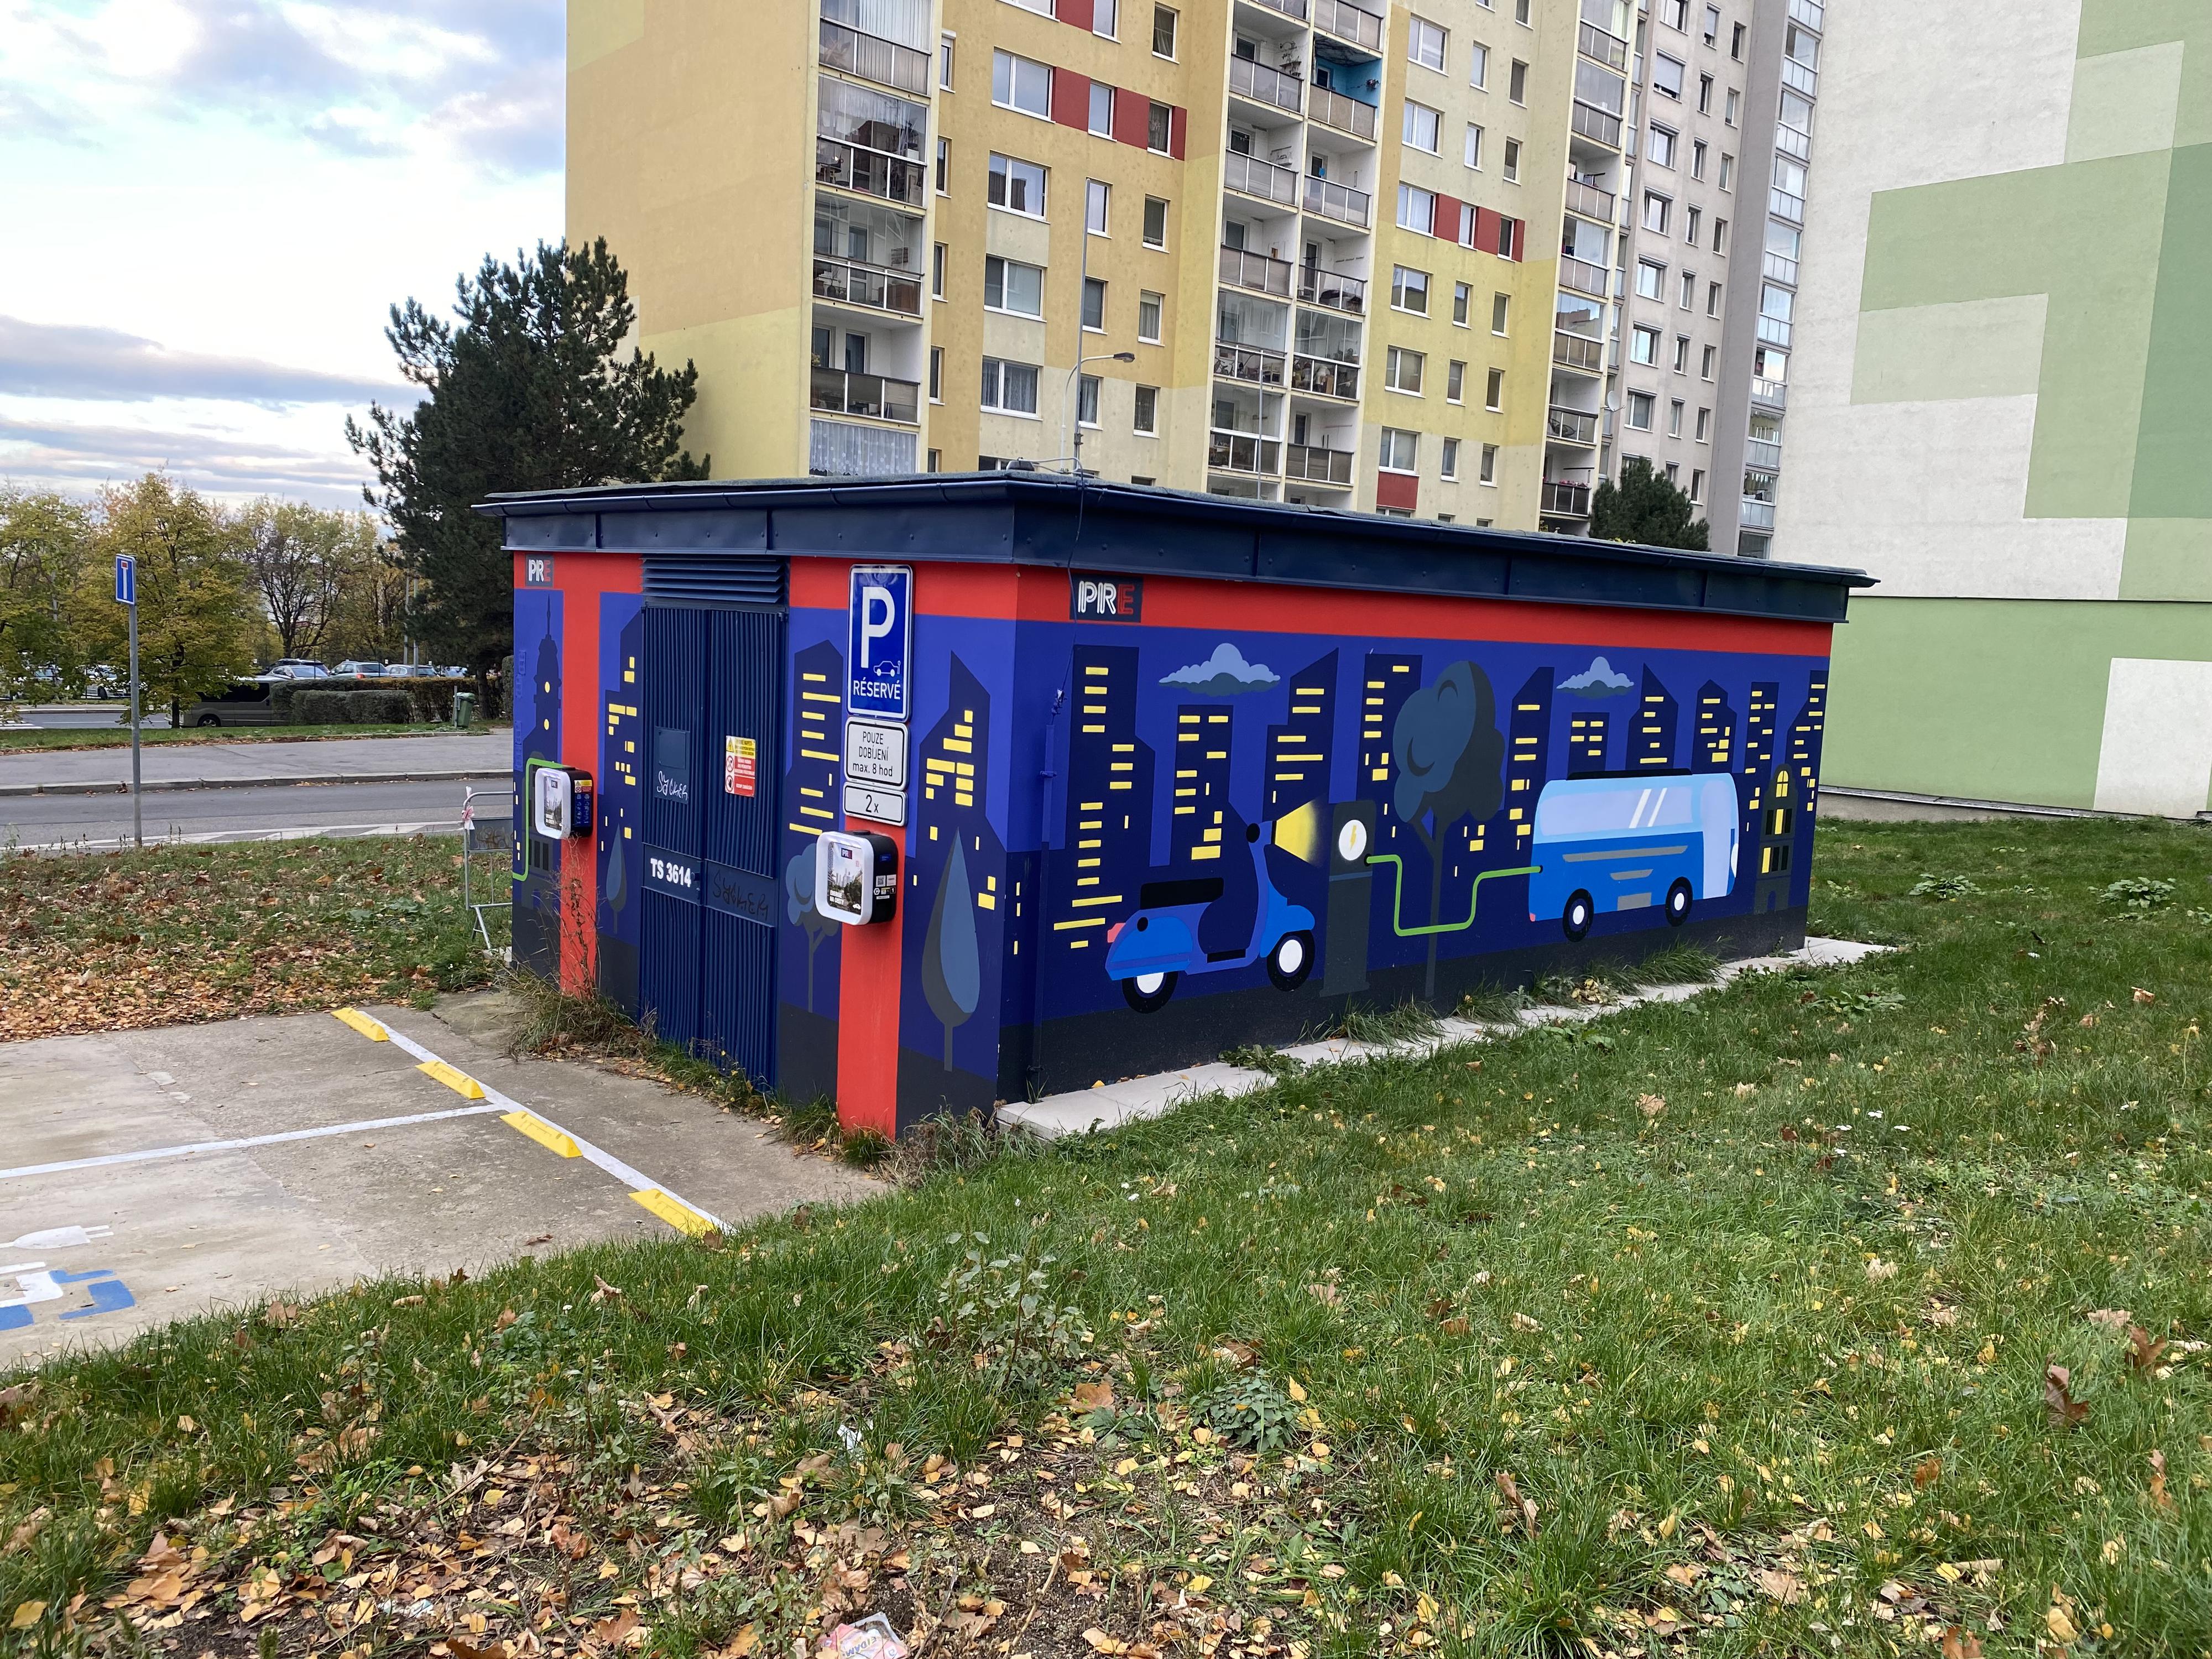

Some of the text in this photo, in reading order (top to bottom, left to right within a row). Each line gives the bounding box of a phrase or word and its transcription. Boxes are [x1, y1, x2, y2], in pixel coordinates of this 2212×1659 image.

[528, 559, 551, 582] PRE
[1078, 581, 1135, 615] PRE
[860, 586, 895, 669] P
[853, 676, 901, 700] RÉSERVÉ
[863, 731, 884, 745] POUZE
[859, 744, 889, 761] DOBÍJENÍ
[853, 763, 893, 777] max. 8 hod
[650, 858, 691, 888] TS 3614
